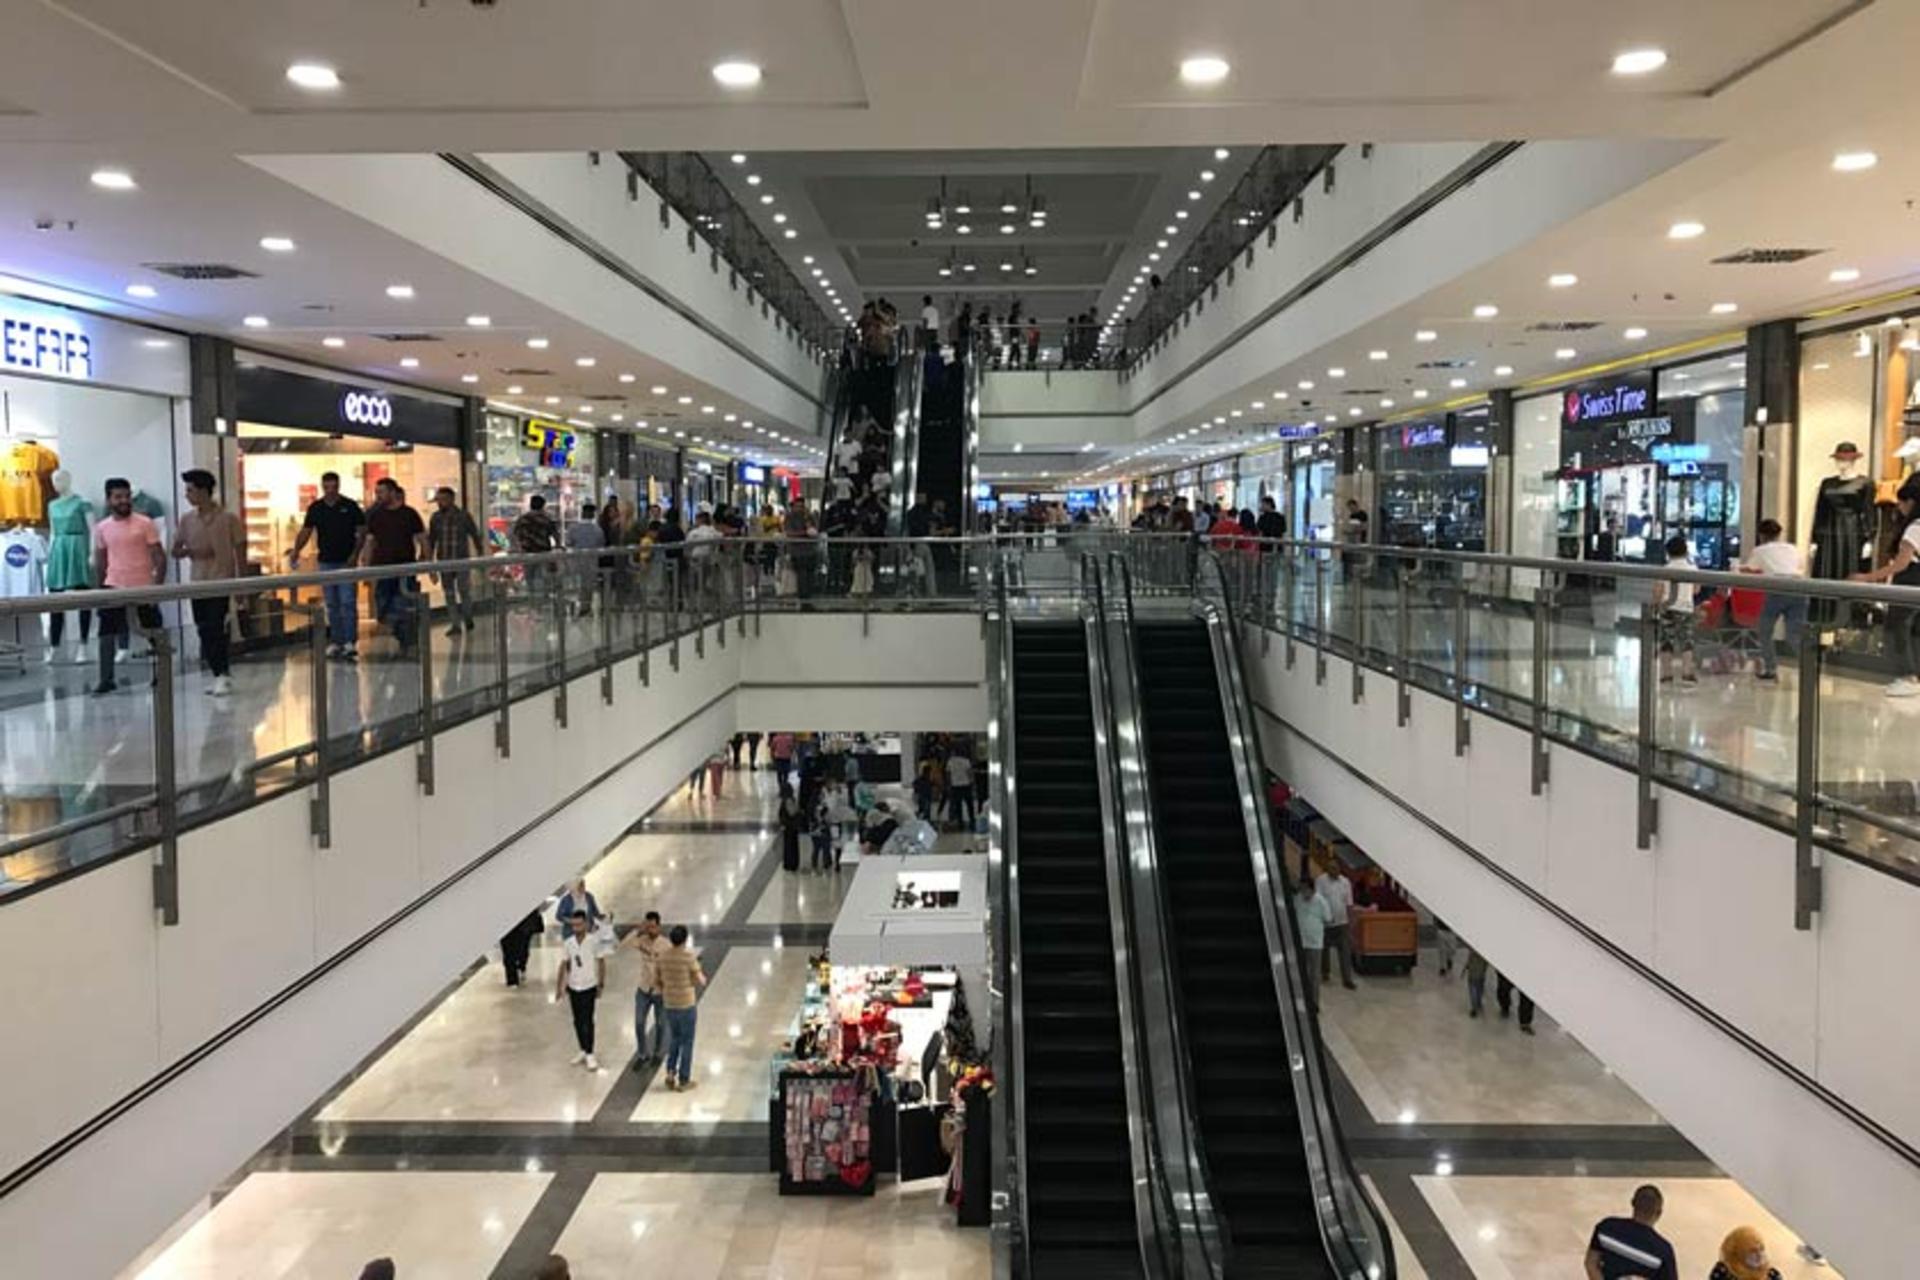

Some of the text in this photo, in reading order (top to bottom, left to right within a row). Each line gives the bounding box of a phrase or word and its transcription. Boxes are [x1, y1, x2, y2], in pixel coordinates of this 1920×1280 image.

[345, 392, 391, 426] ecco
[1582, 386, 1647, 419] Swiss Time
